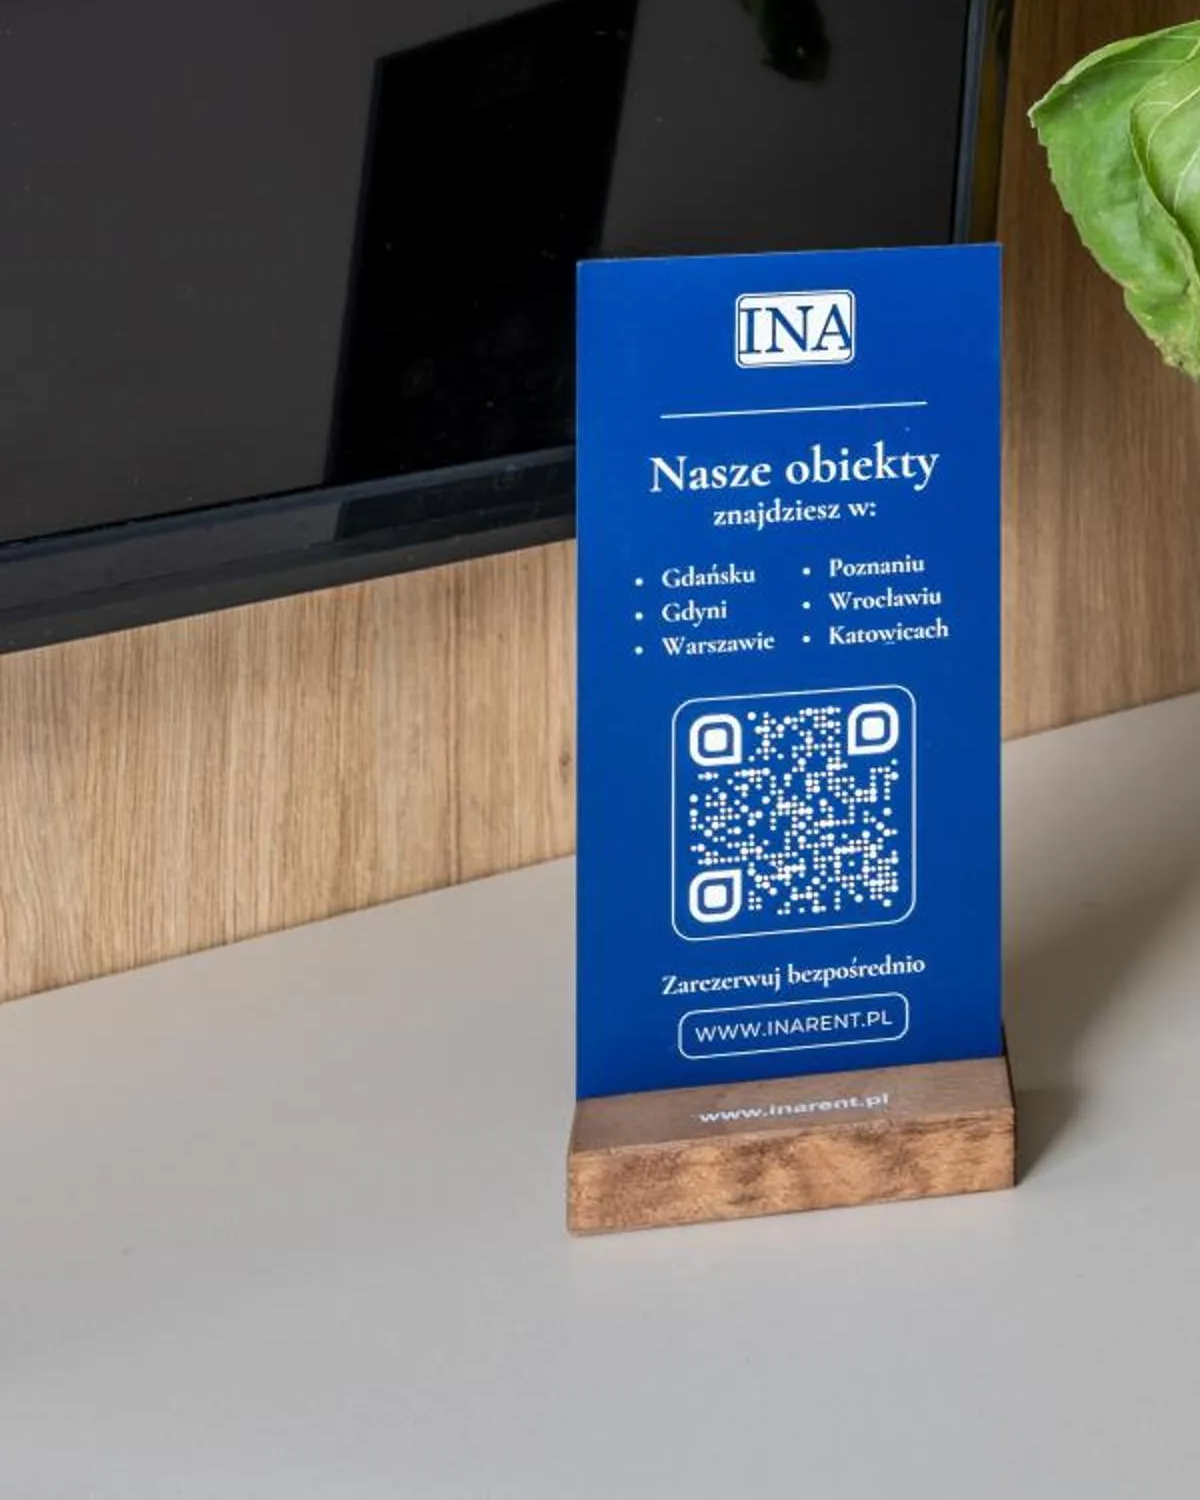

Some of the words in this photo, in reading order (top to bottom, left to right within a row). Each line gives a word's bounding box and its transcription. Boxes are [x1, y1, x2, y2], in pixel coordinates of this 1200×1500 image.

[739, 303, 851, 354] INA
[649, 455, 772, 493] Nasze
[785, 440, 940, 491] obiekty
[712, 497, 841, 531] znajdziesz
[847, 502, 877, 518] w:
[661, 562, 755, 589] Gdańsku
[829, 554, 926, 577] Poznaniu
[661, 599, 728, 628] Gdyni
[661, 631, 776, 656] Warszawie
[828, 616, 950, 646] Katowicach
[661, 966, 782, 996] Zarezerwuj
[787, 954, 926, 988] bezpośrednio
[695, 1009, 893, 1042] WWW.INARENT.PL
[699, 1093, 889, 1123] www.inarent.pl
